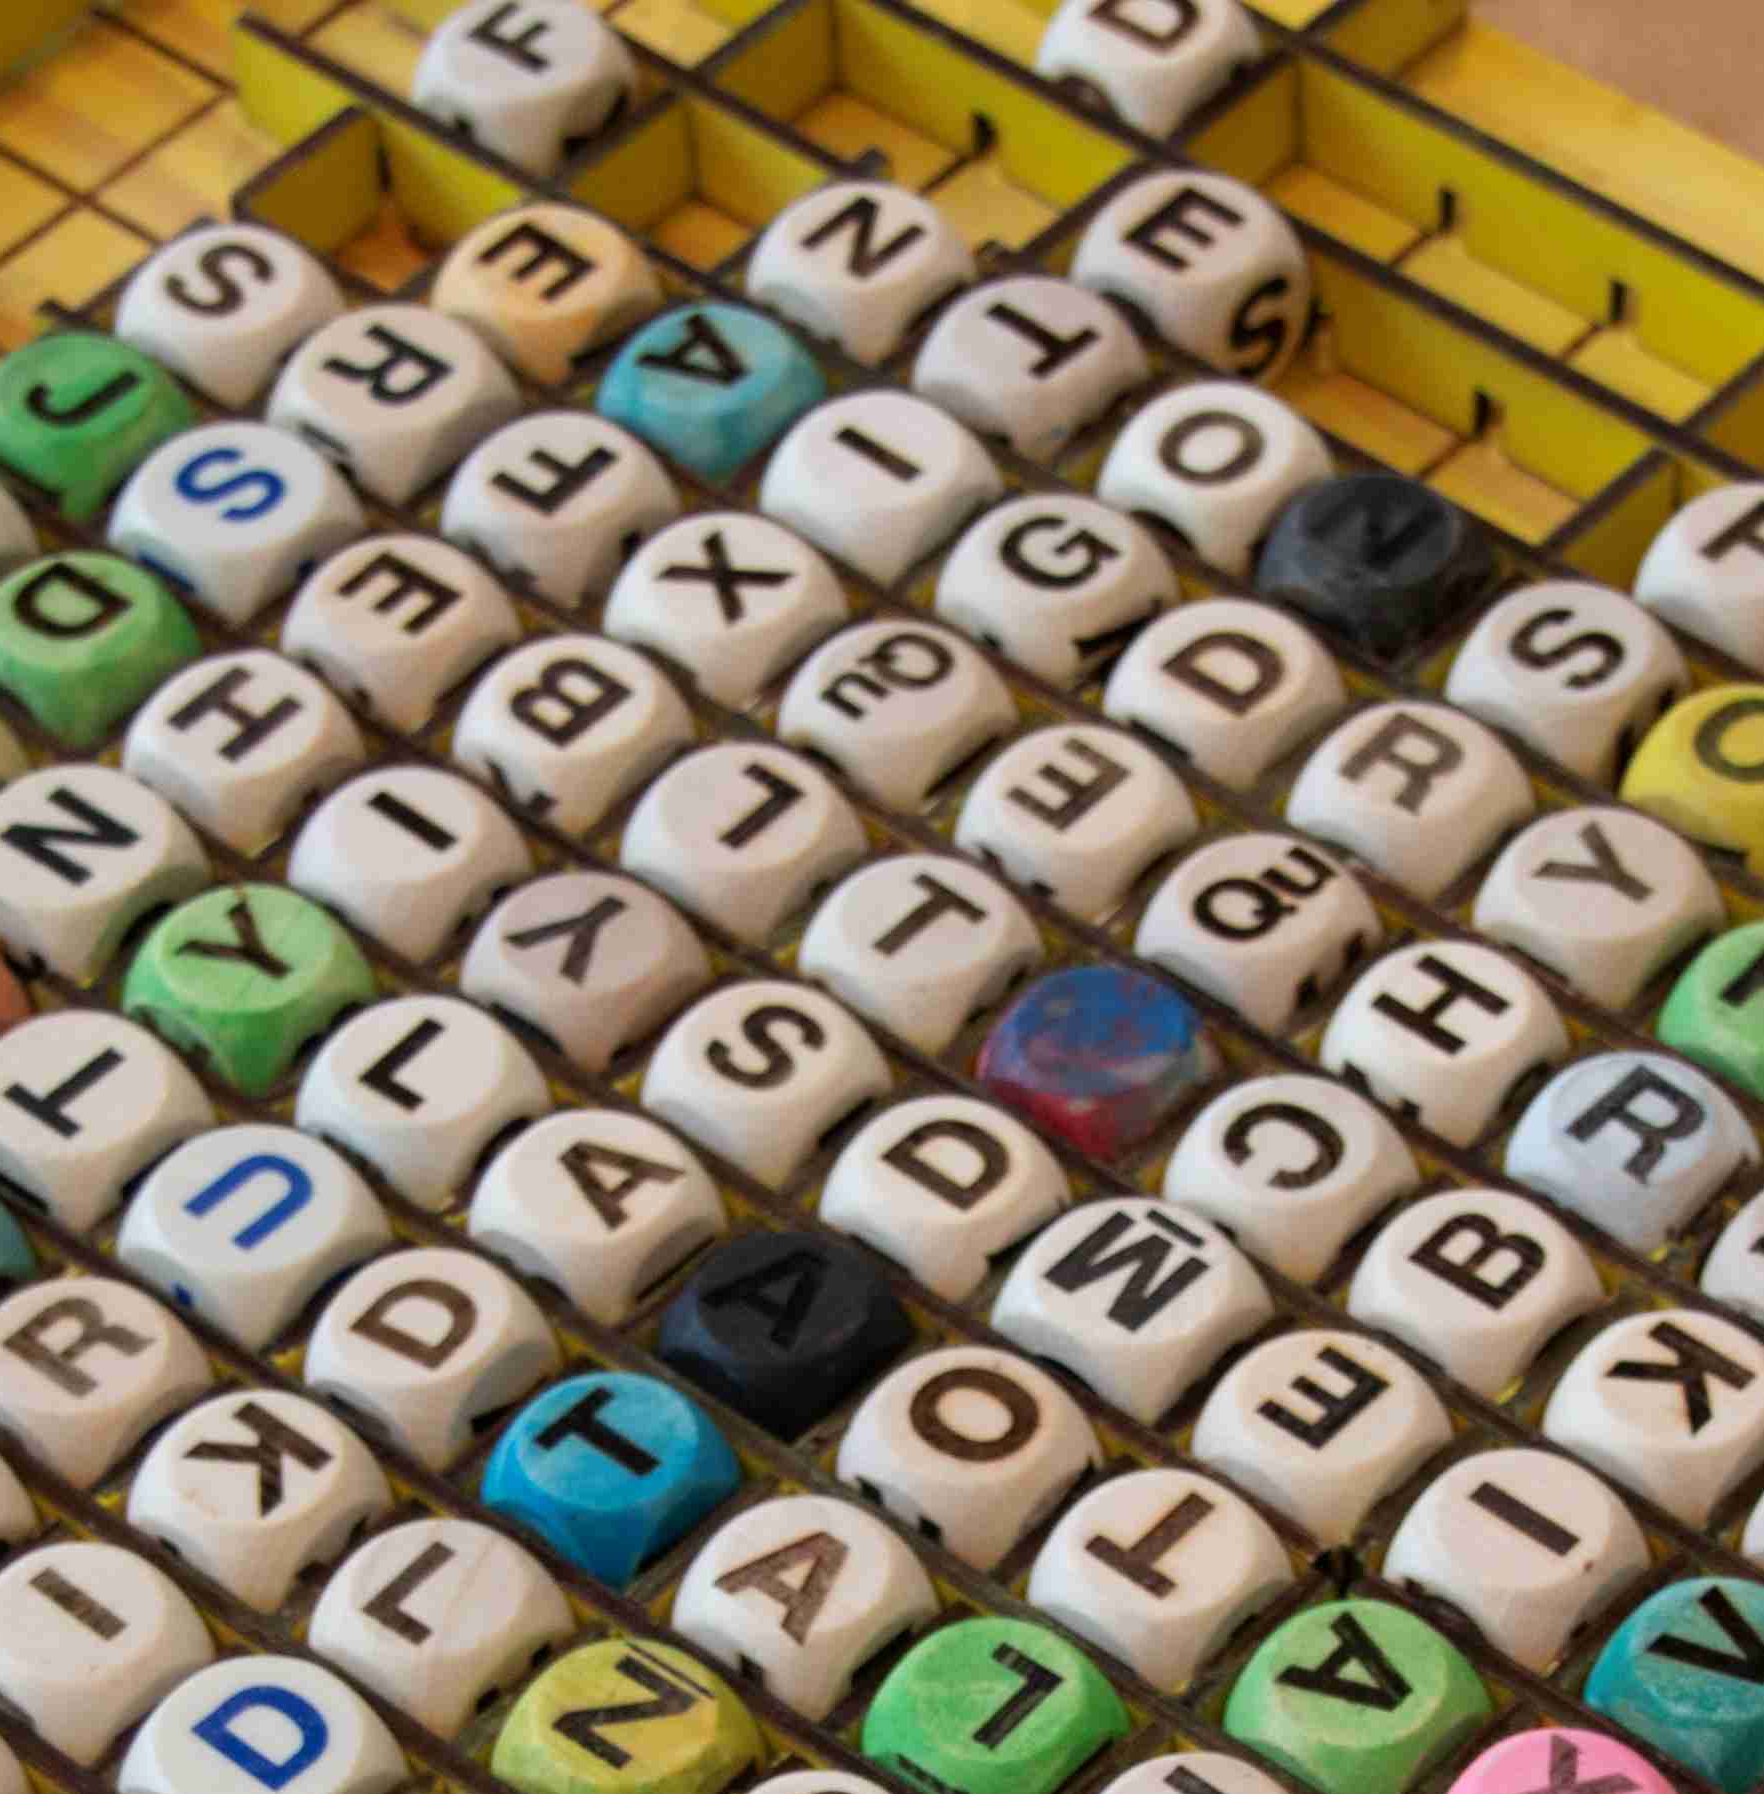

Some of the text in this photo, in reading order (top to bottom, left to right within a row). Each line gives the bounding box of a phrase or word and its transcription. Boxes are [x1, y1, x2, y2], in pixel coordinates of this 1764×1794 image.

[479, 222, 595, 301] E
[1124, 187, 1243, 271] E
[323, 325, 451, 405] R
[987, 303, 1099, 378] T
[492, 447, 616, 515] F
[836, 427, 920, 481] I
[338, 552, 461, 634] E
[660, 532, 791, 623] X
[1000, 516, 1119, 590] G
[1510, 609, 1625, 689] S
[169, 667, 301, 761] H
[510, 658, 631, 747] B
[368, 792, 456, 851] I
[720, 763, 804, 849] L
[177, 898, 291, 979] Y
[874, 874, 987, 955] T
[706, 1005, 825, 1088] S
[1373, 955, 1509, 1054] H
[4, 1049, 123, 1137] T
[360, 1019, 443, 1110] L
[882, 1119, 1009, 1210] D
[1223, 1103, 1344, 1189] C
[1567, 1066, 1705, 1184] R
[560, 1142, 685, 1229] A
[1410, 1214, 1545, 1310] B
[909, 1367, 1040, 1462] O
[1258, 1347, 1389, 1449] E
[1607, 1322, 1754, 1433] K
[186, 1402, 331, 1516] K
[534, 1388, 660, 1477] T
[1085, 1492, 1214, 1598] T
[1470, 1482, 1579, 1556] I
[363, 1542, 454, 1645] L
[973, 1643, 1063, 1750] L
[1277, 1612, 1412, 1711] A
[193, 1686, 328, 1790] D
